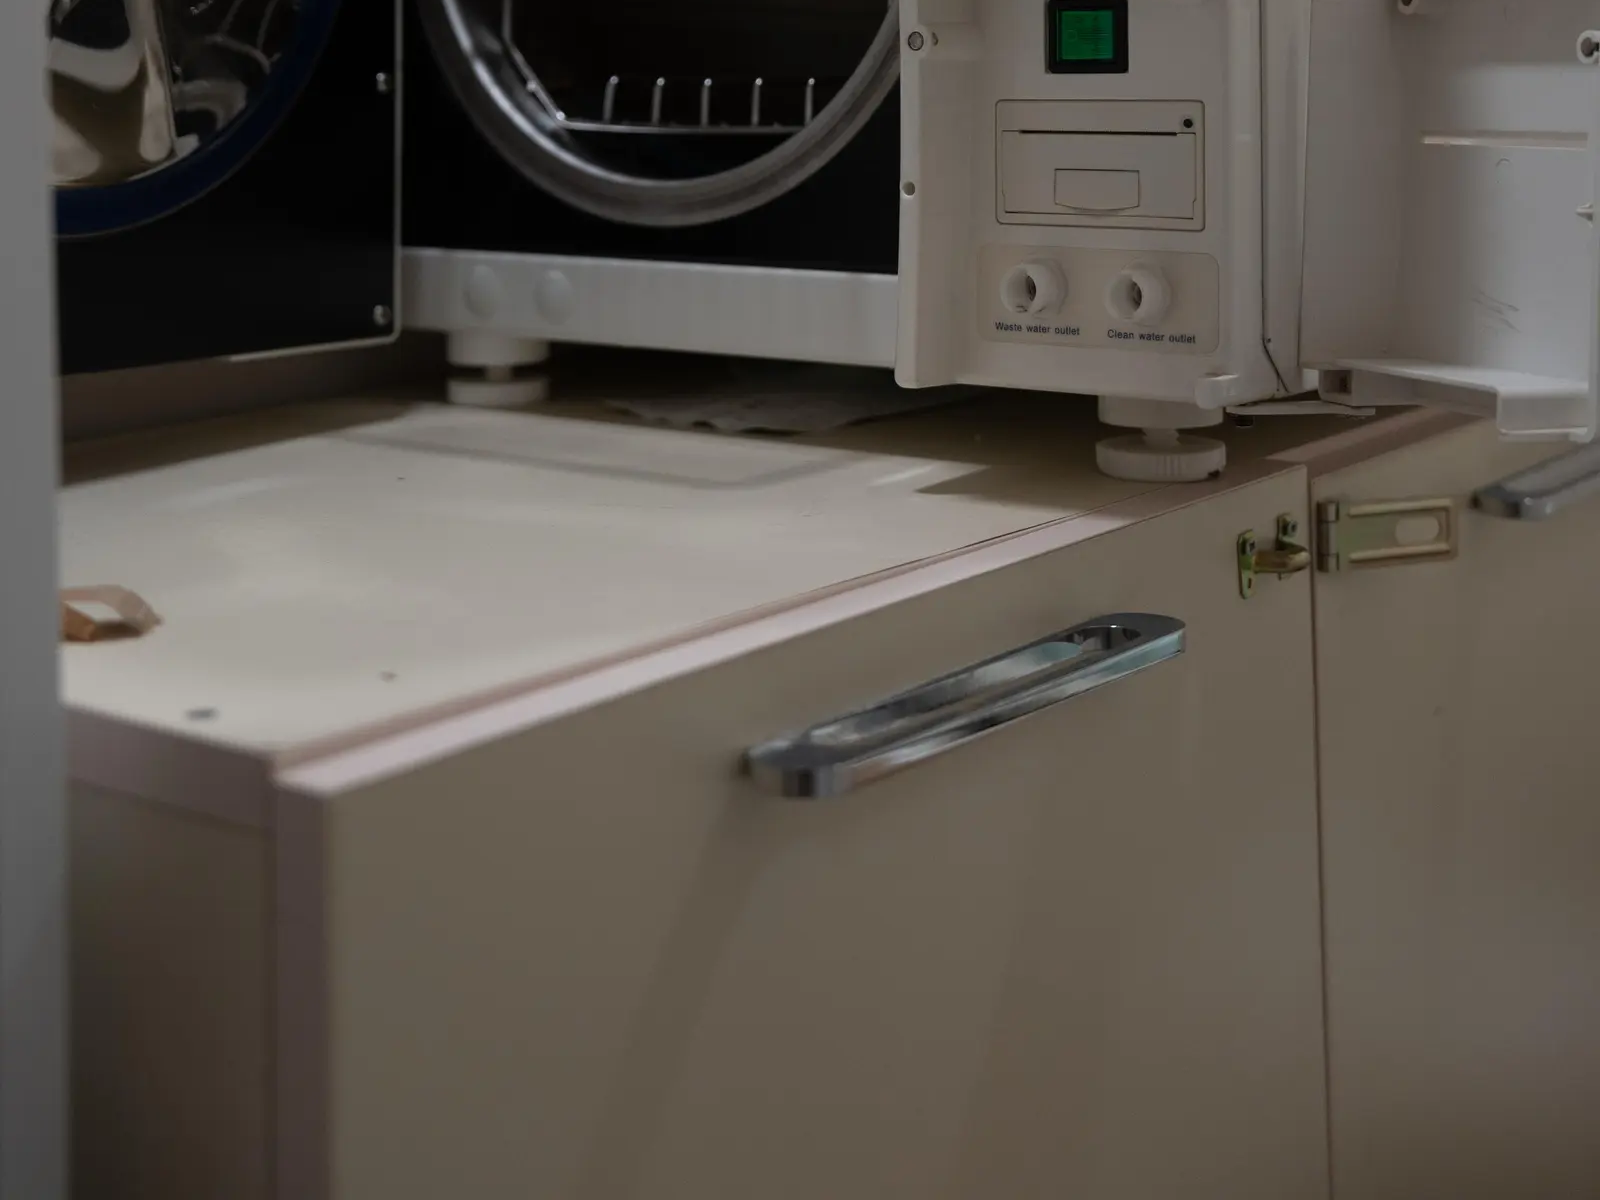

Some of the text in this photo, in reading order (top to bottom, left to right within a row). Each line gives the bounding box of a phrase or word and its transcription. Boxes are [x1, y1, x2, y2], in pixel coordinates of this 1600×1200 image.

[995, 321, 1080, 336] Waste water outlet
[1107, 329, 1196, 344] Clean water outlet
